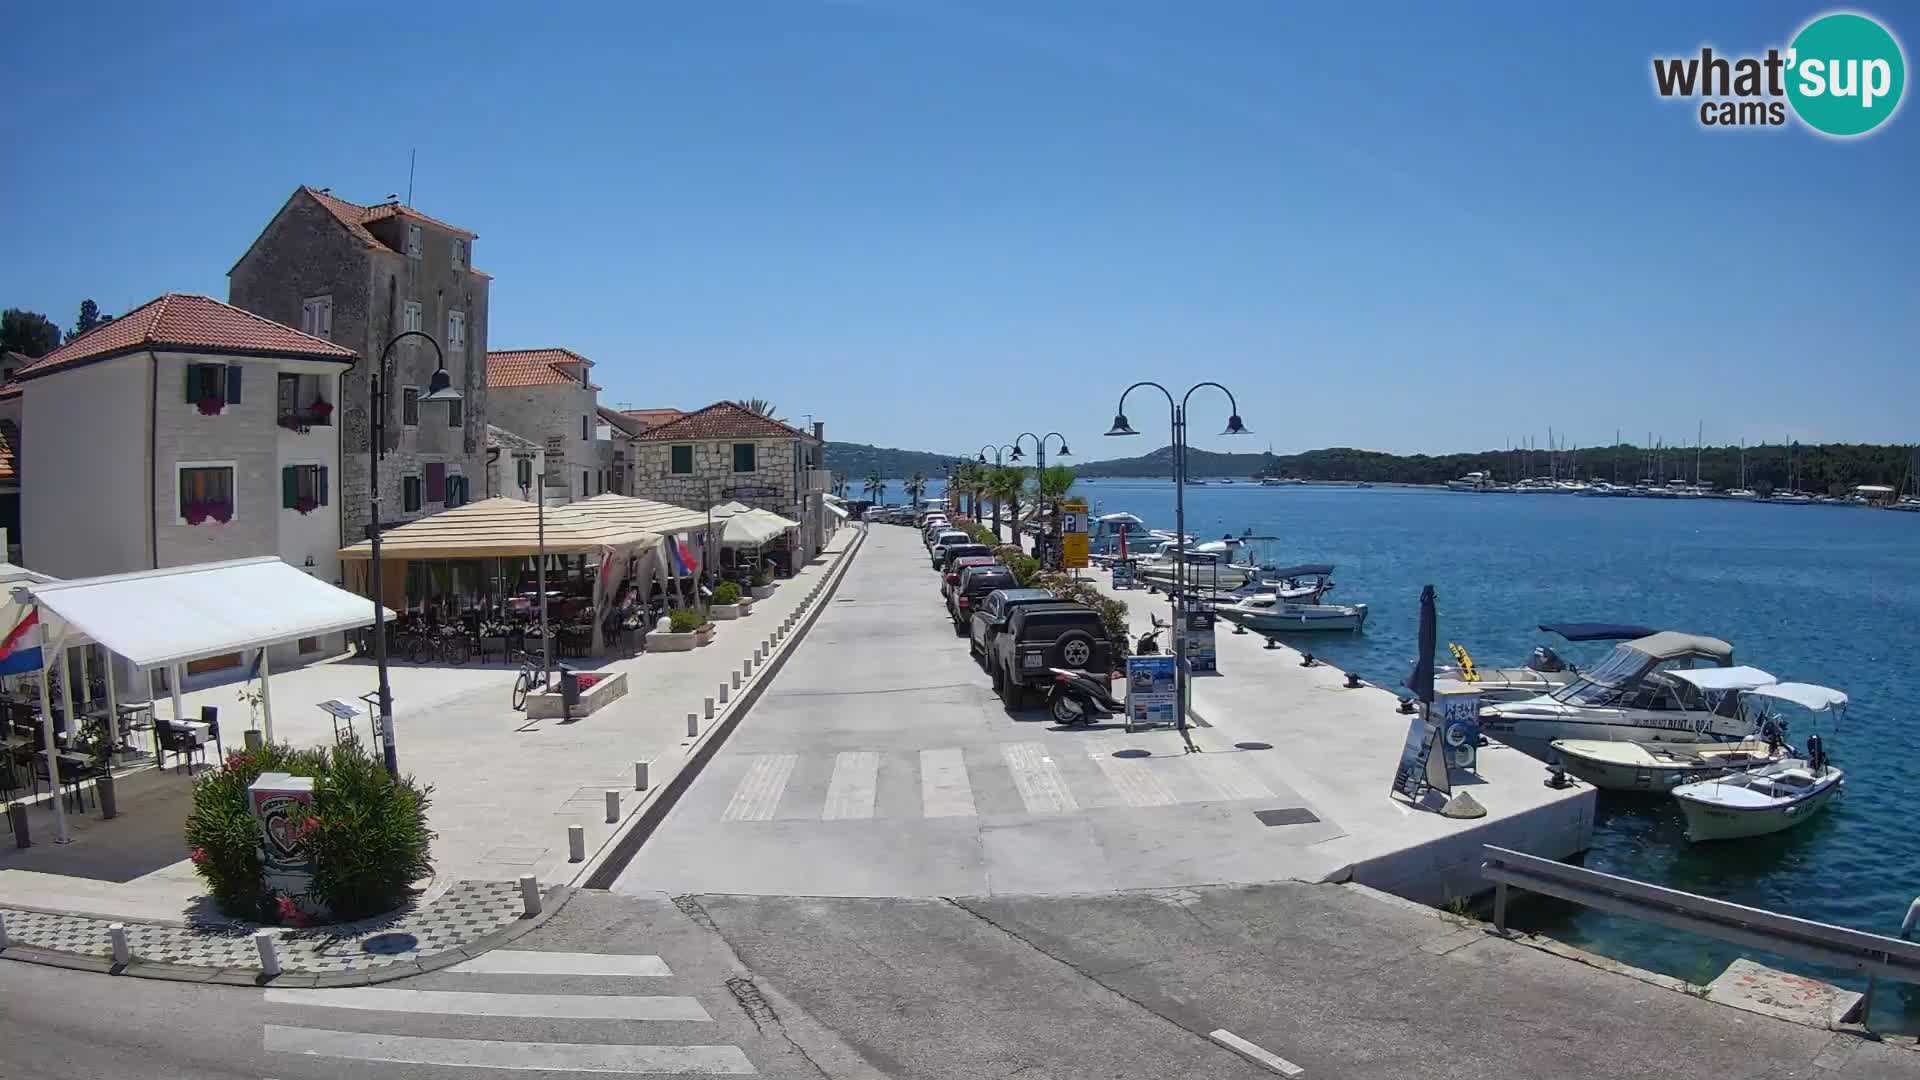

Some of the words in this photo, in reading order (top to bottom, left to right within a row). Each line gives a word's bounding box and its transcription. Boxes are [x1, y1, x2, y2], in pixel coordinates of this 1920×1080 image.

[1065, 514, 1075, 531] P
[1668, 719, 1688, 729] RENT
[1695, 719, 1713, 732] BOAT
